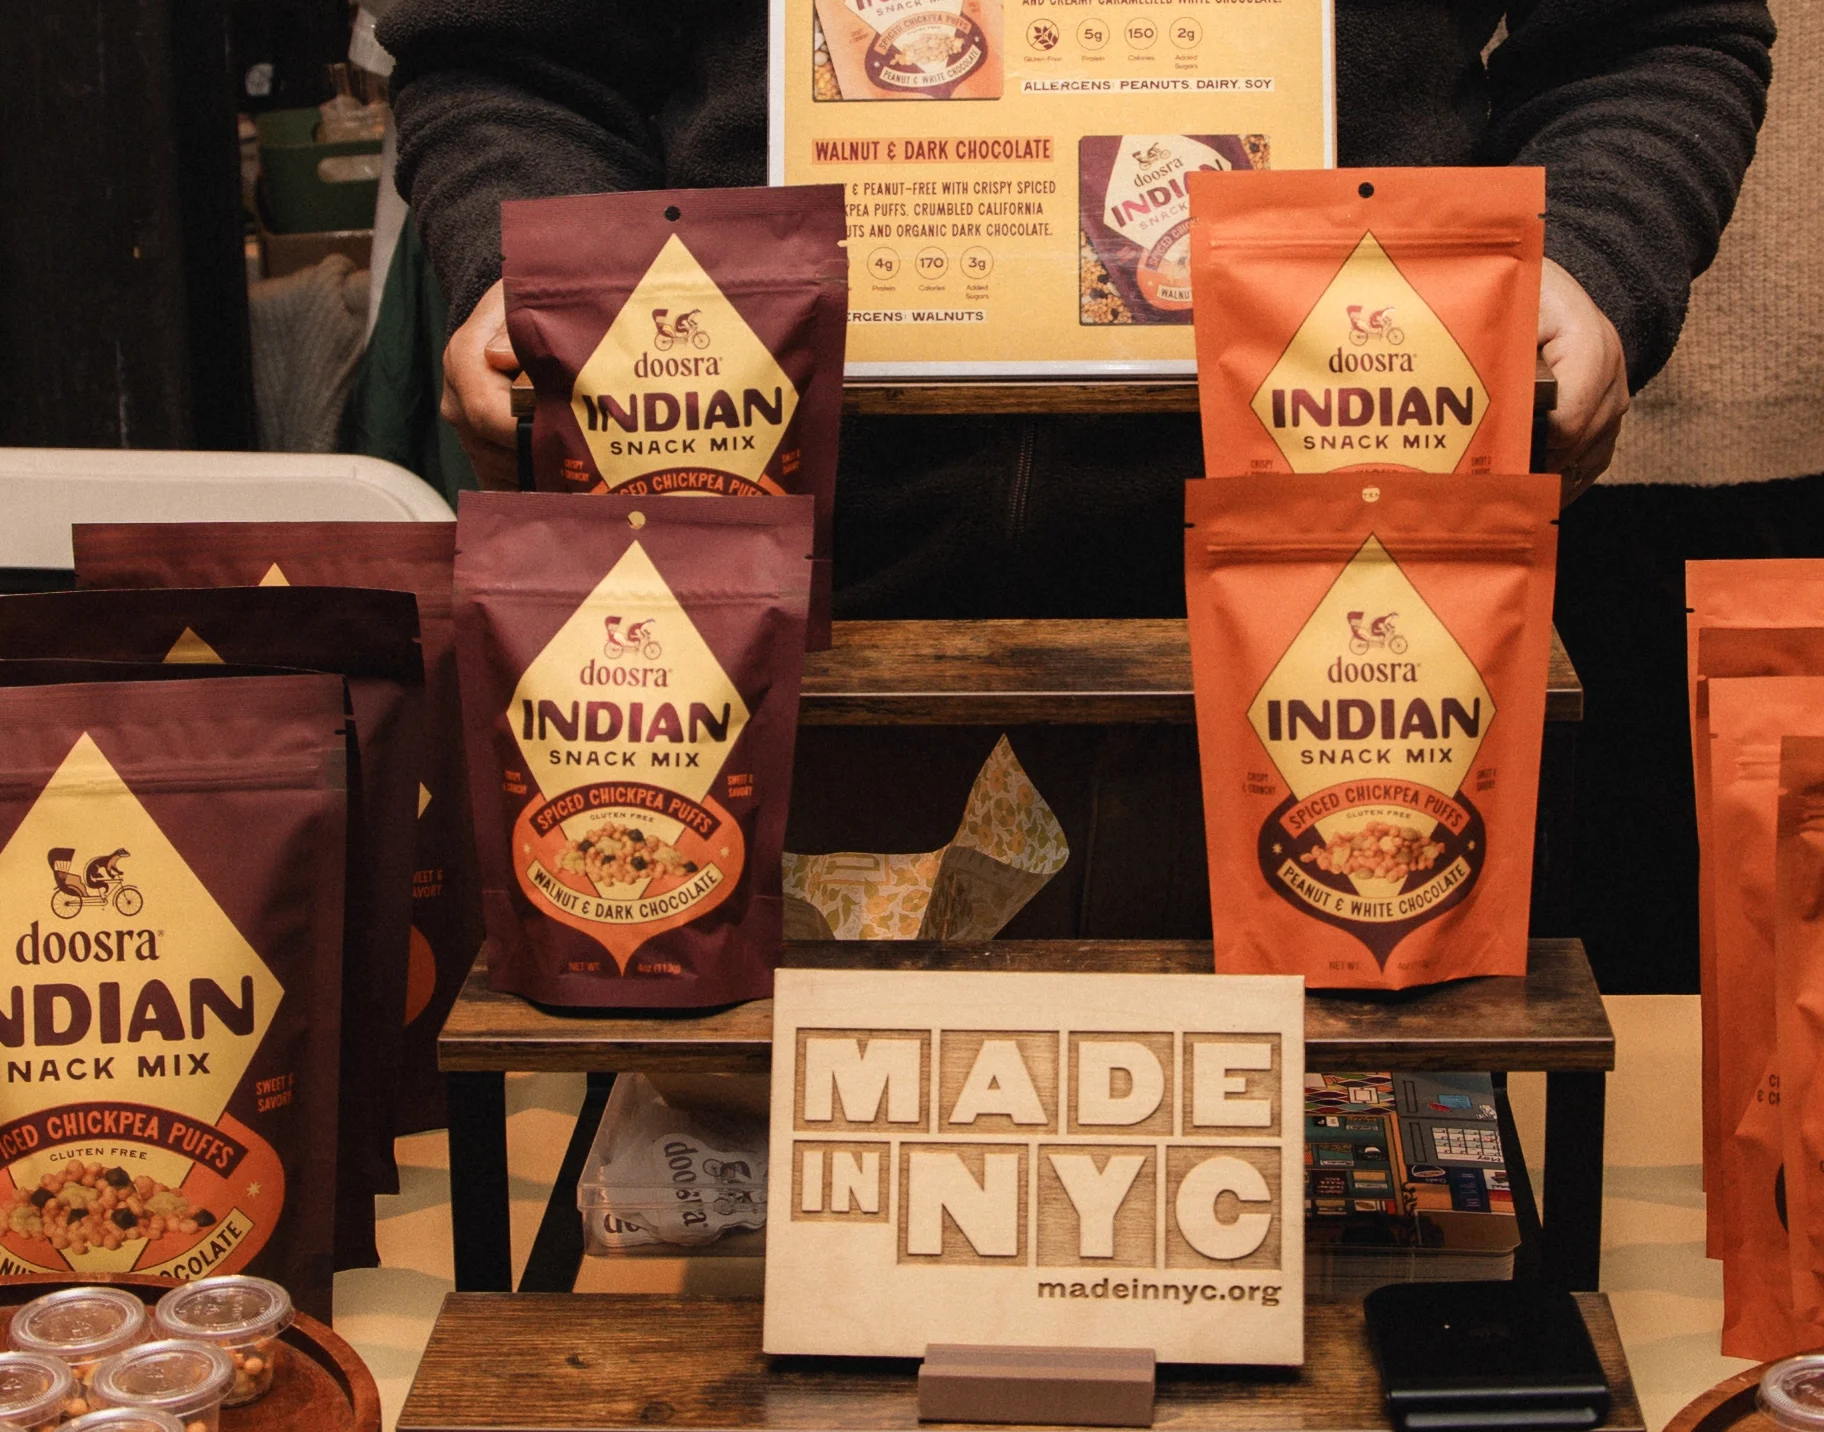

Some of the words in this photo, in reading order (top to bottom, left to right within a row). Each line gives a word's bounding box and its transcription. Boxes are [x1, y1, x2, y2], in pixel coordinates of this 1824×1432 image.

[816, 141, 879, 160] WALNUT
[888, 142, 896, 160] &
[905, 141, 948, 159] DARK
[956, 140, 1049, 159] CHOCOLATE
[582, 386, 783, 433] INDIAN
[1272, 386, 1473, 428] INDIAN
[610, 438, 696, 456] SNACK
[710, 435, 755, 452] MIX
[1303, 435, 1389, 450] SNACK
[1403, 434, 1447, 449] MIX
[522, 699, 731, 743] INDIAN
[1267, 697, 1480, 741] INDIAN
[549, 750, 636, 767] SNACK
[651, 752, 699, 767] MIX
[1301, 749, 1391, 764] SNACK
[1406, 748, 1453, 763] MIX
[138, 1052, 212, 1077] MIX
[803, 1037, 1272, 1128] MADE
[46, 1109, 160, 1141] CHICKPEA
[169, 1121, 234, 1170] PUFFS
[802, 1150, 880, 1213] IN
[906, 1152, 1272, 1260] NYC
[1037, 1277, 1282, 1307] madeinnyc.org
